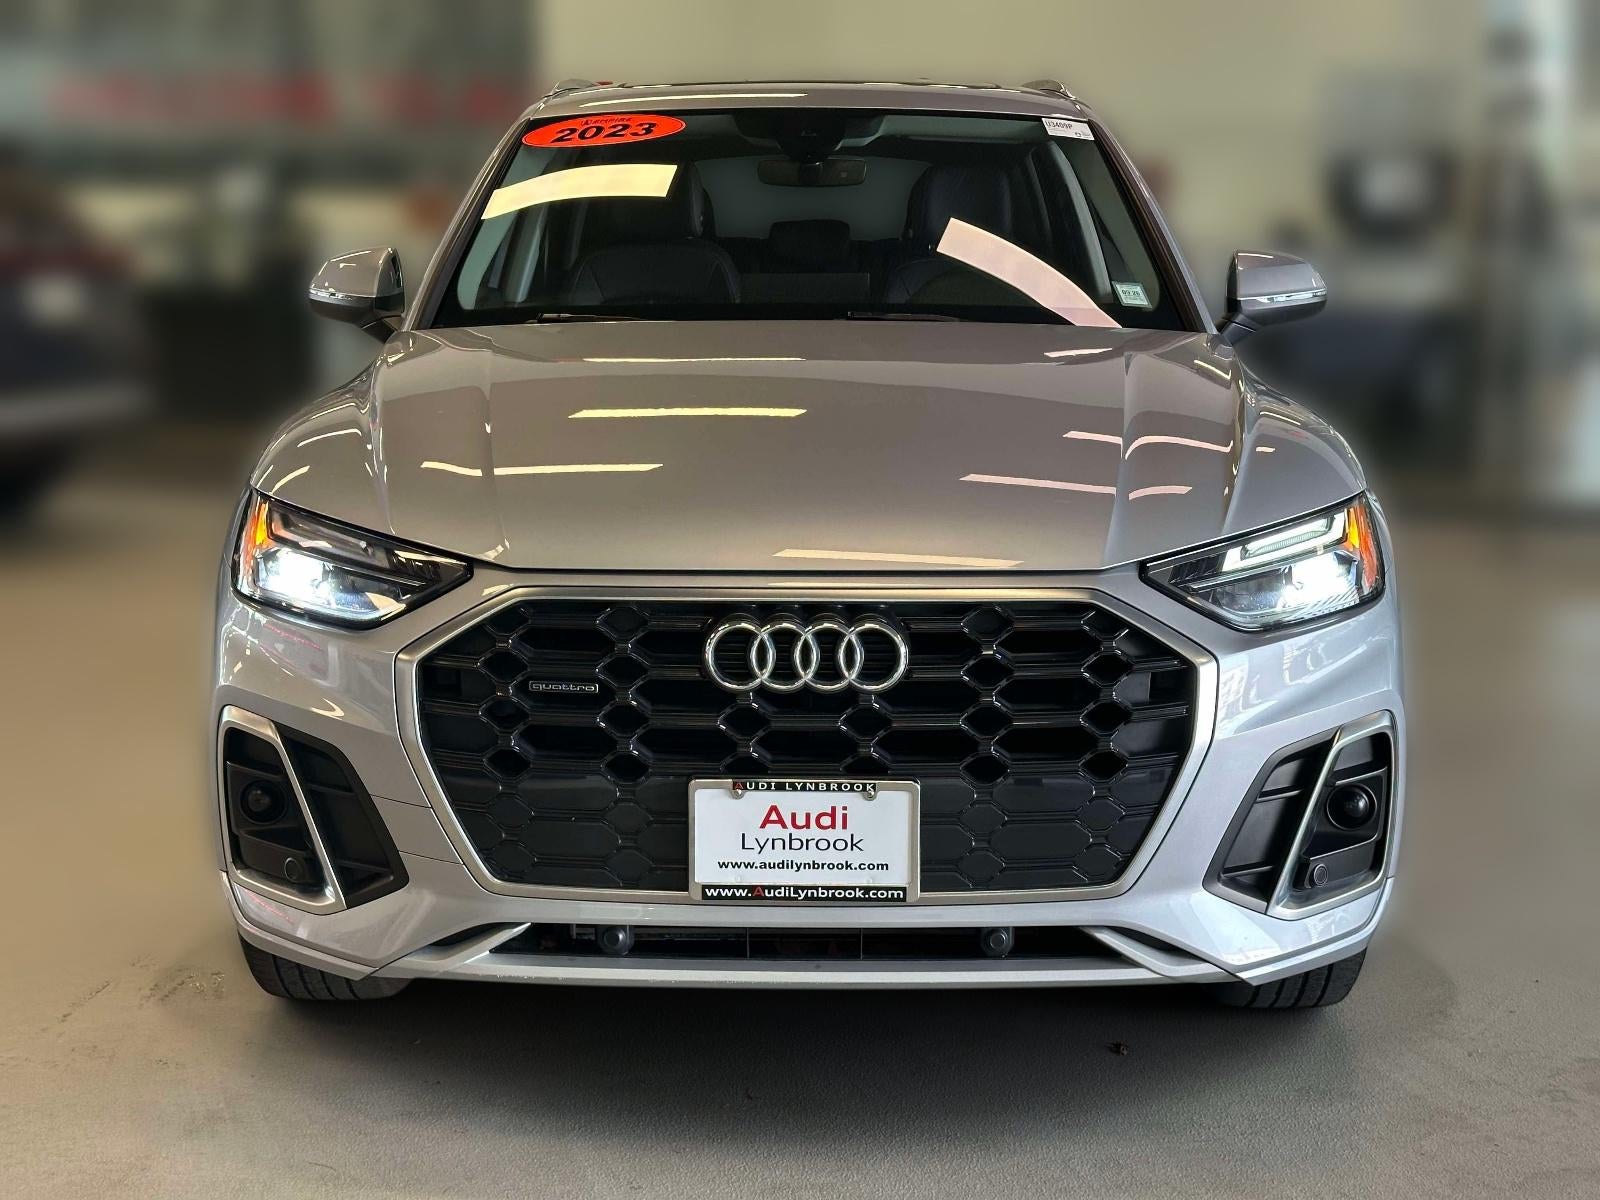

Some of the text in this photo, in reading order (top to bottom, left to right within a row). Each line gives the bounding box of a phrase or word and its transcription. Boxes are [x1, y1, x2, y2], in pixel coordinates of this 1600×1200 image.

[551, 122, 657, 143] 2023
[532, 683, 595, 691] quattro
[735, 782, 874, 791] AUDI LYNBROOK
[759, 804, 848, 830] Audi
[741, 832, 864, 854] Lynbrook
[718, 859, 889, 872] www.audilynbrook.com
[705, 886, 904, 900] www.AudiLynbrook.com
